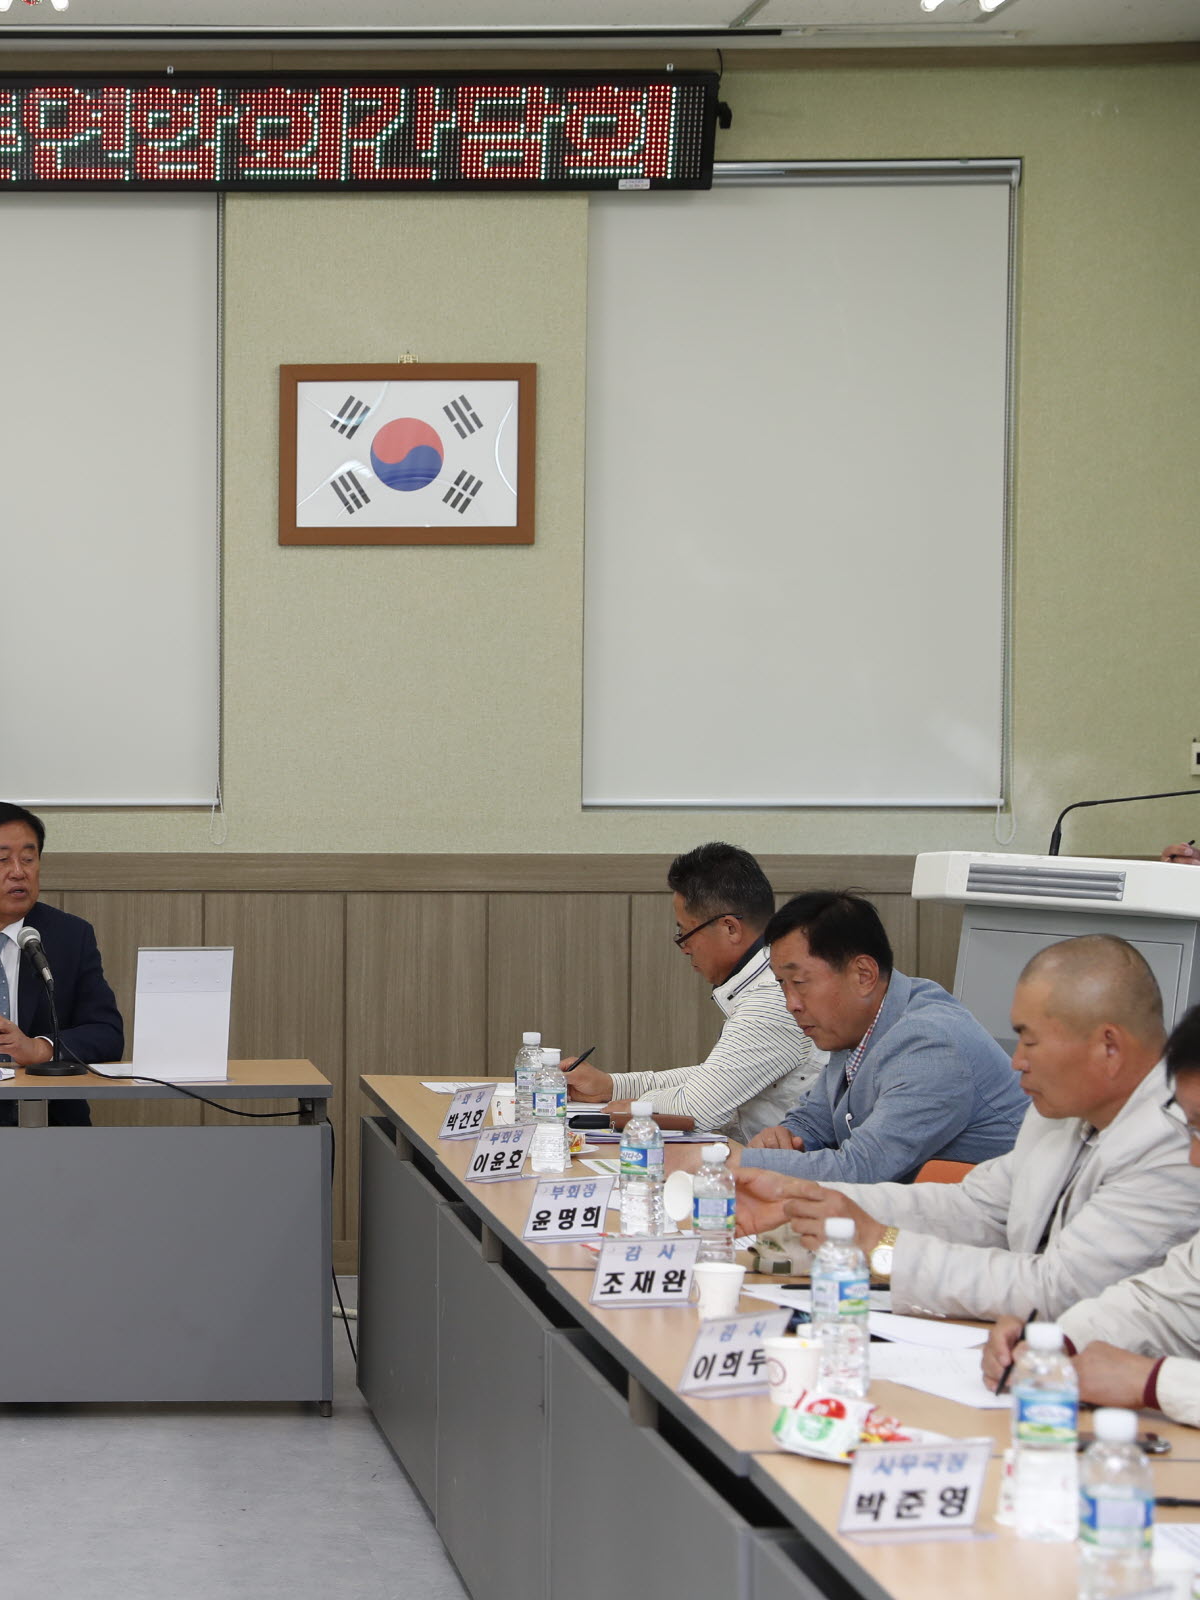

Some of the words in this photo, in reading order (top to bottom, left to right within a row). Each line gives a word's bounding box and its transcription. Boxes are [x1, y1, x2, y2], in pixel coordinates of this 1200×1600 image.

[446, 1109, 484, 1131] 박건호
[490, 1129, 524, 1145] 부회장
[473, 1149, 523, 1173] 이윤호
[550, 1183, 596, 1200] 부회장
[532, 1205, 601, 1231] 윤명희
[599, 1269, 687, 1294] 조재완
[693, 1348, 767, 1381] 이희두
[873, 1452, 968, 1475] 사무국장
[856, 1484, 970, 1522] 박준영
